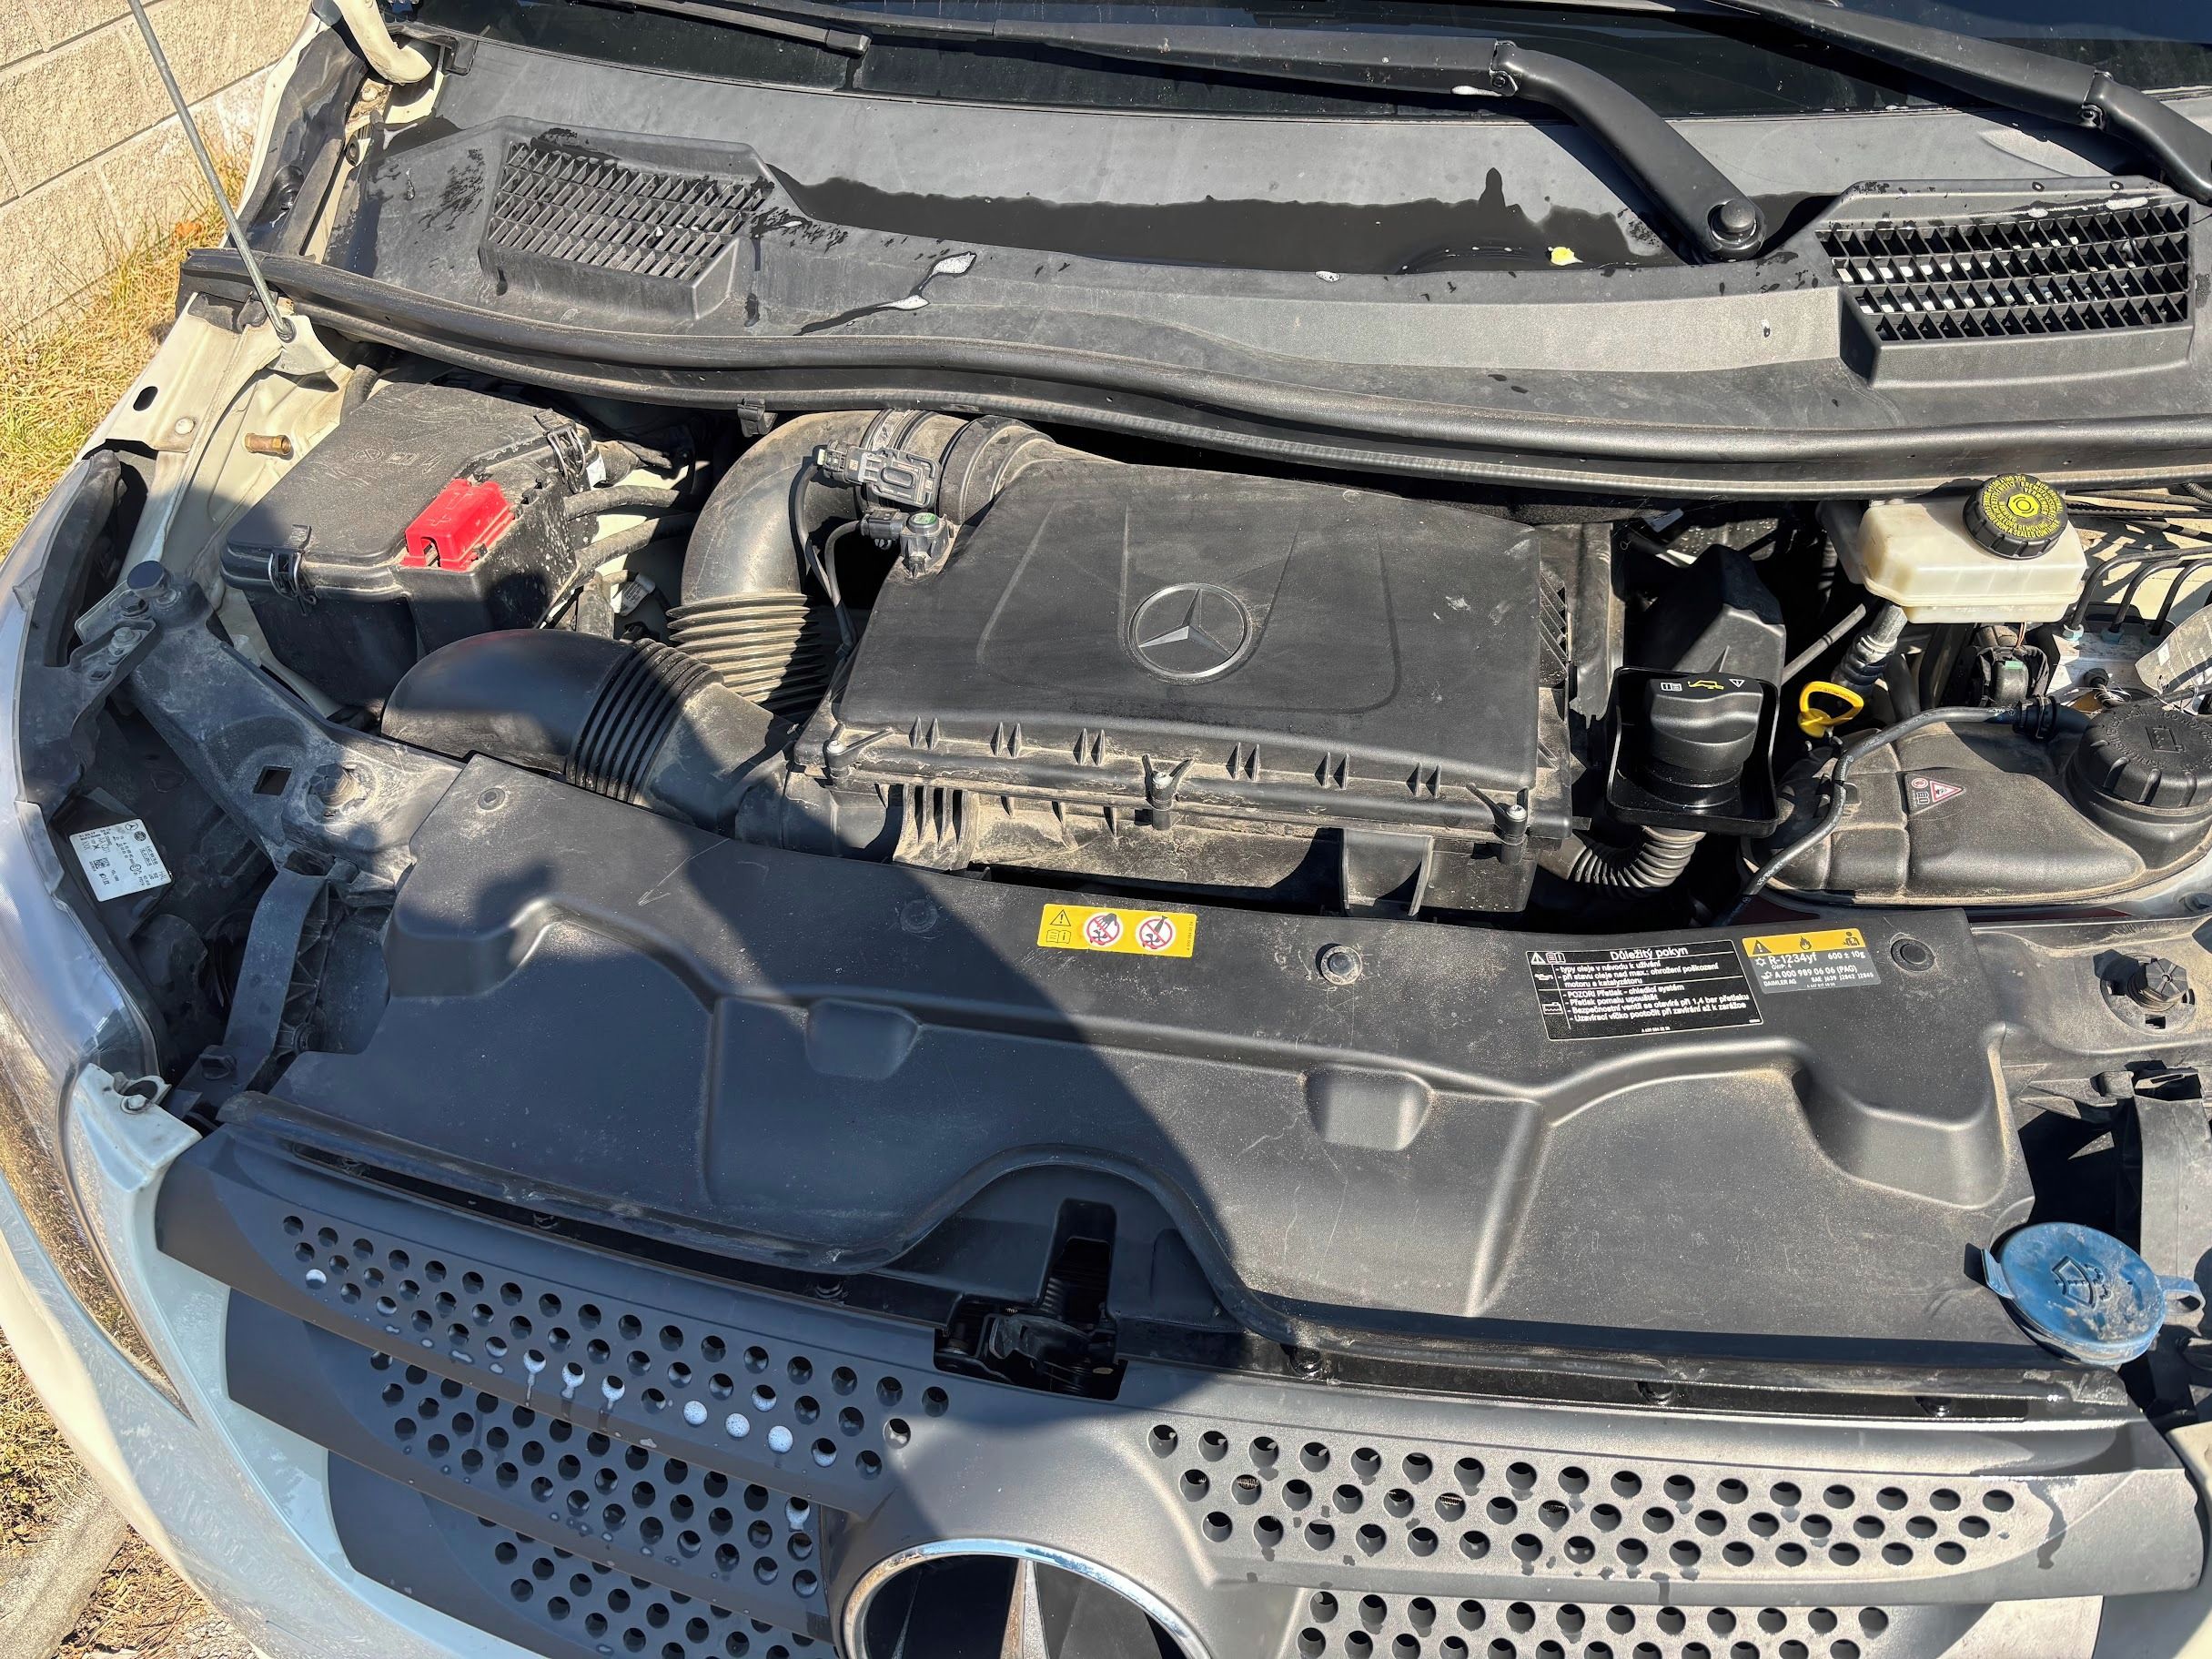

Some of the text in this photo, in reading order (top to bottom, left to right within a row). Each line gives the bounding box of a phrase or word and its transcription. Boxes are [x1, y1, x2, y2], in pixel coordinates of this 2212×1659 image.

[2018, 521, 2048, 531] REMOVING
[2036, 520, 2060, 537] CONTAINER
[1656, 947, 1689, 958] pokyn
[1768, 952, 1817, 965] R-1234yf
[1852, 951, 1865, 959] 10g
[1577, 965, 1594, 973] oleje
[1602, 963, 1628, 971] návodu
[1782, 970, 1796, 978] 000
[1798, 968, 1812, 976] 989
[1815, 967, 1823, 976] 06
[1825, 966, 1835, 975] 06
[1837, 965, 1858, 974] (PAG)
[1594, 971, 1612, 979] oleje
[1598, 996, 1624, 1006] pomalu
